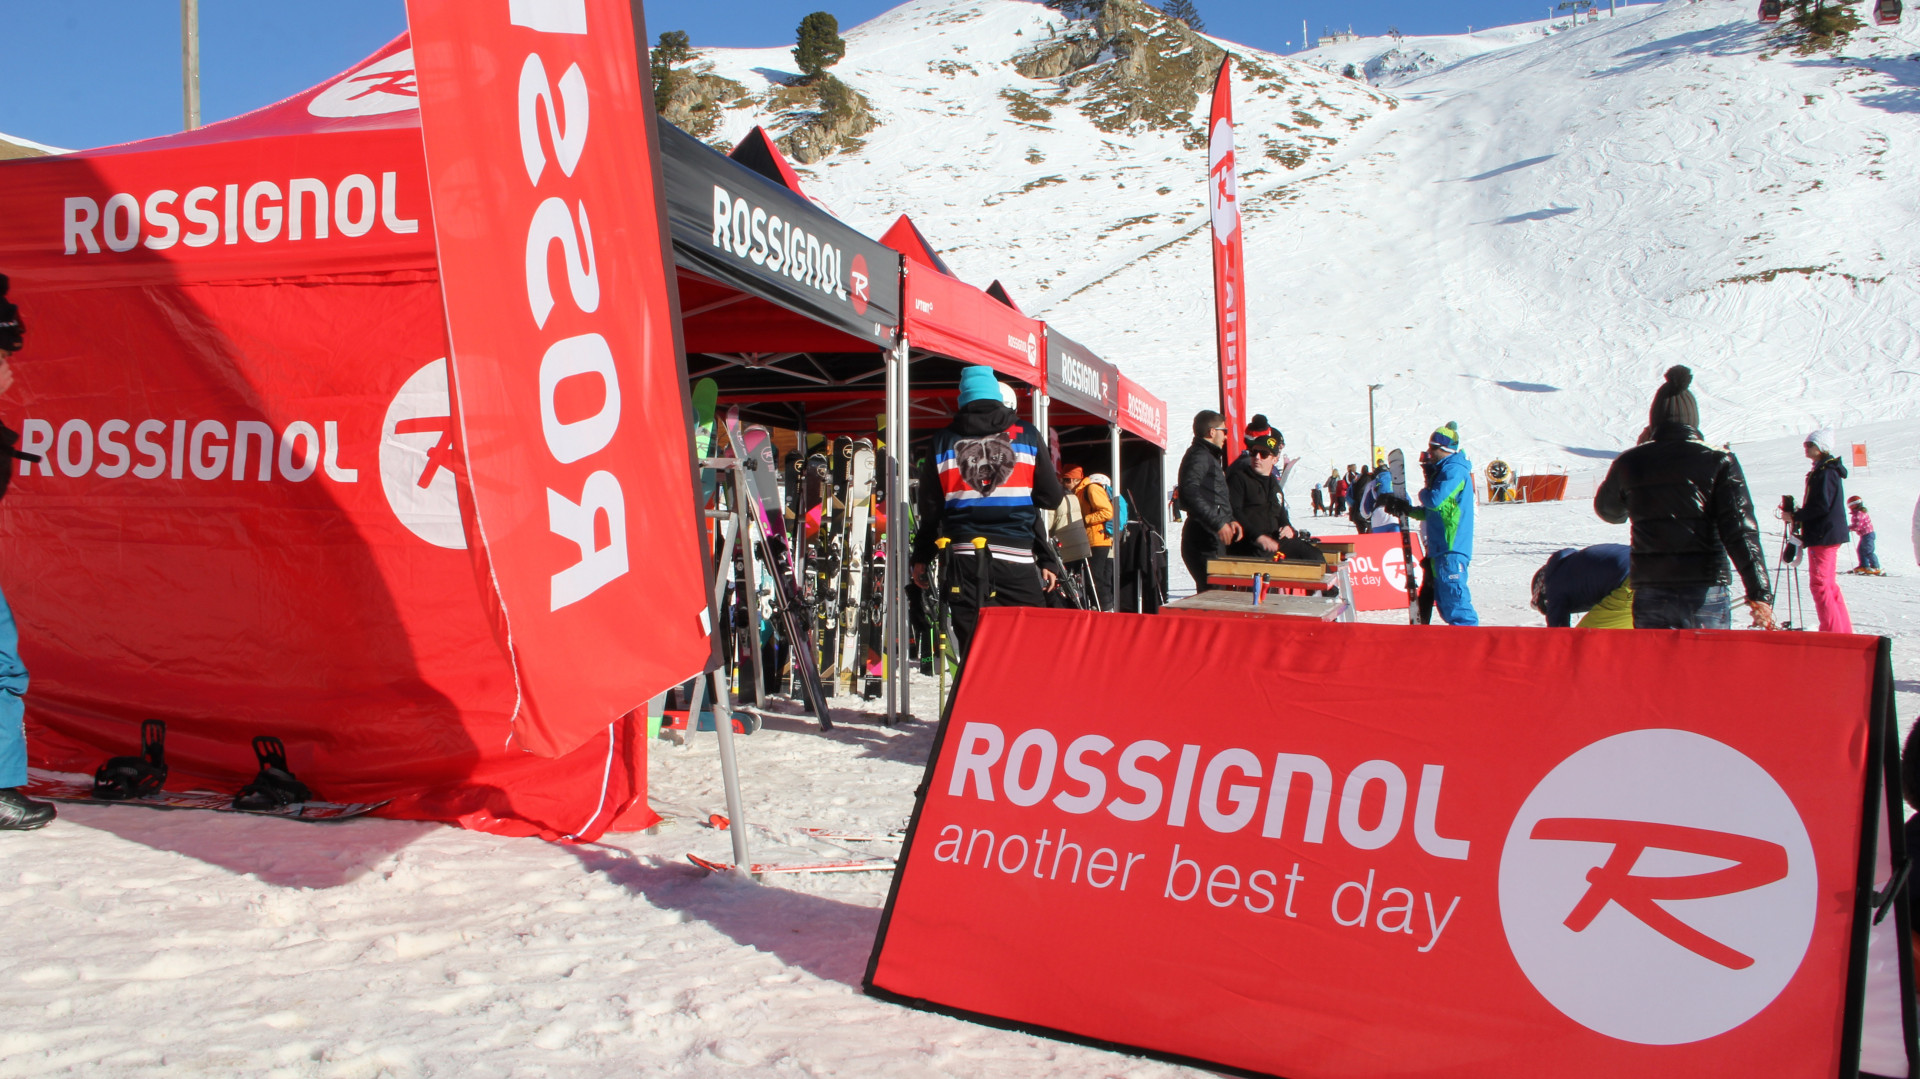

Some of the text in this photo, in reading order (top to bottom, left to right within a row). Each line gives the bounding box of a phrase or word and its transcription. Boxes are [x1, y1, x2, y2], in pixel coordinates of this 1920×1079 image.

[65, 172, 418, 254] ROSSIGNOL
[712, 185, 847, 301] ROSSIGNOL
[1061, 352, 1101, 400] ROSSIGNOL
[20, 418, 358, 483] ROSSIGNOL
[1361, 574, 1381, 586] day
[949, 722, 1788, 969] ROSSIGNOL R
[934, 824, 1461, 953] another best day
